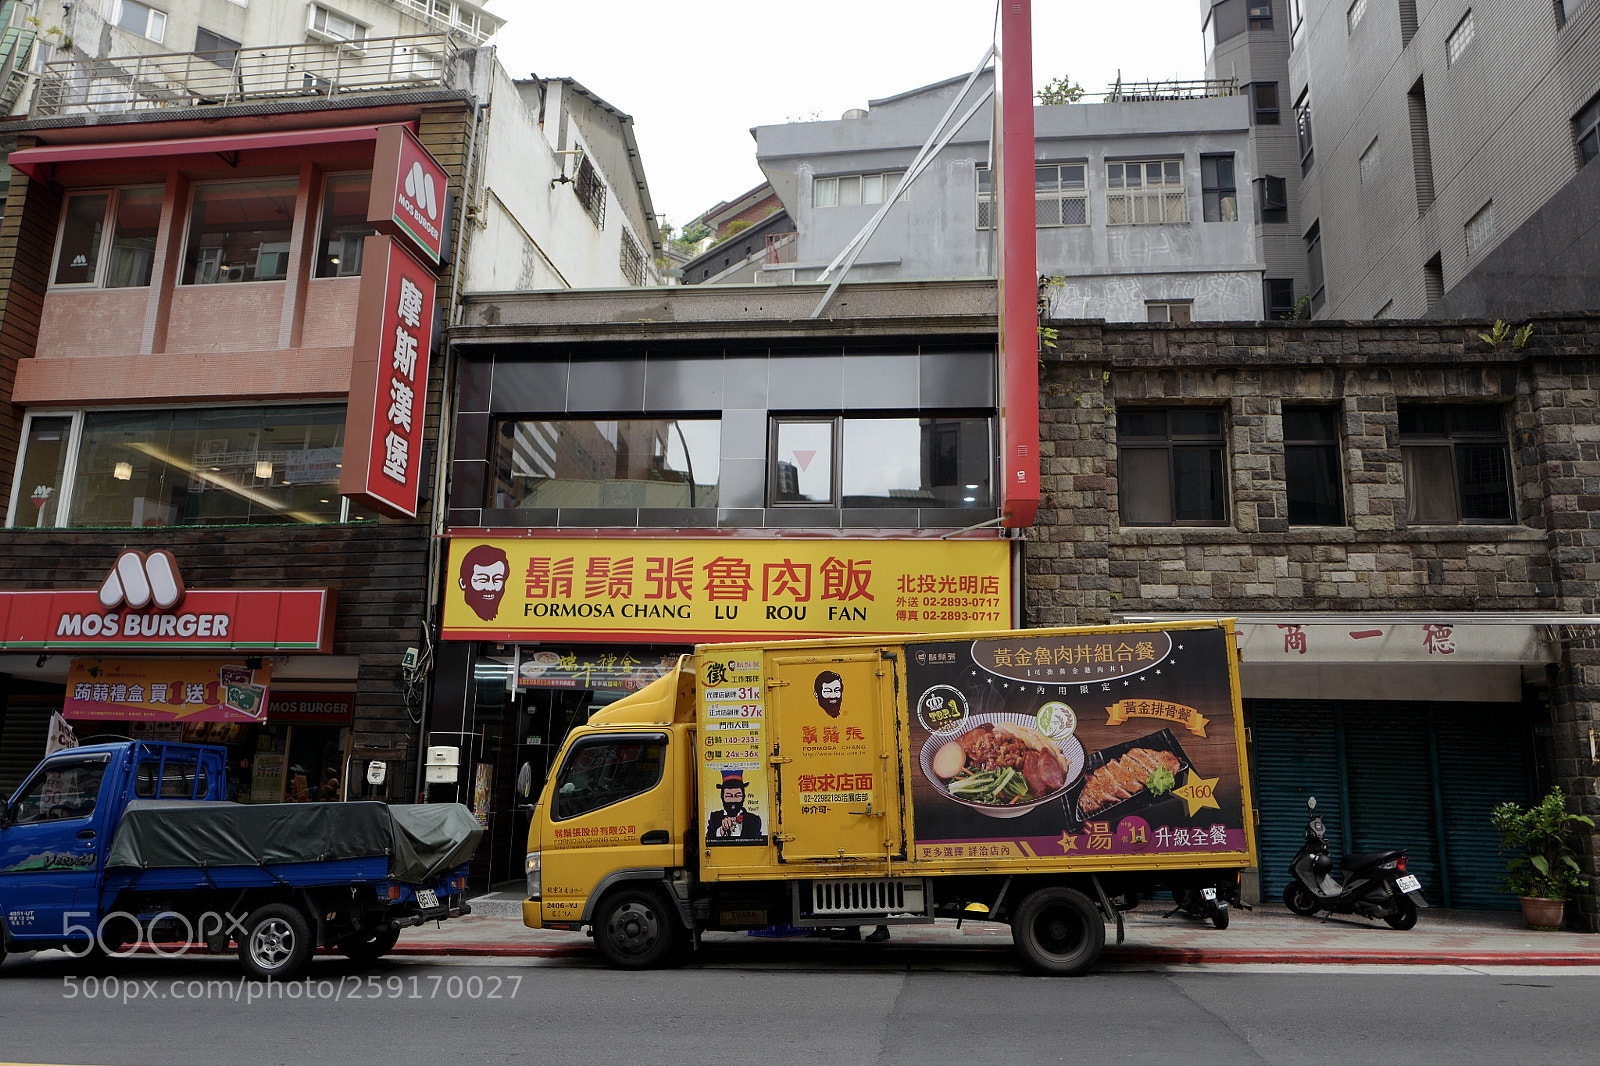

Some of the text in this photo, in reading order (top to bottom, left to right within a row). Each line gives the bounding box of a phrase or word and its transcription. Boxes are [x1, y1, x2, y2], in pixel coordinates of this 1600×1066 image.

[398, 193, 440, 241] MOS BURGER
[382, 276, 424, 484] 摩斯漢堡
[524, 556, 875, 603] 鬍鬚張魯肉飯
[896, 574, 1000, 595] 北投光明店
[524, 602, 867, 621] FORMOSA CHANG LU ROU FAN
[896, 596, 1001, 609] 外送 02-2893-0717
[56, 613, 230, 637] MOS BURGER
[896, 609, 1001, 622] 傳真 02-2893-0717
[738, 687, 760, 700] 31K
[269, 701, 349, 714] MOS BURGER
[740, 705, 763, 717] 37K
[1123, 701, 1193, 723] 黃金排骨餐
[802, 725, 866, 745] 鬍鬚張
[798, 773, 874, 793] 徵求店面
[1086, 821, 1114, 851] 湯
[1155, 825, 1227, 848] 升級全餐
